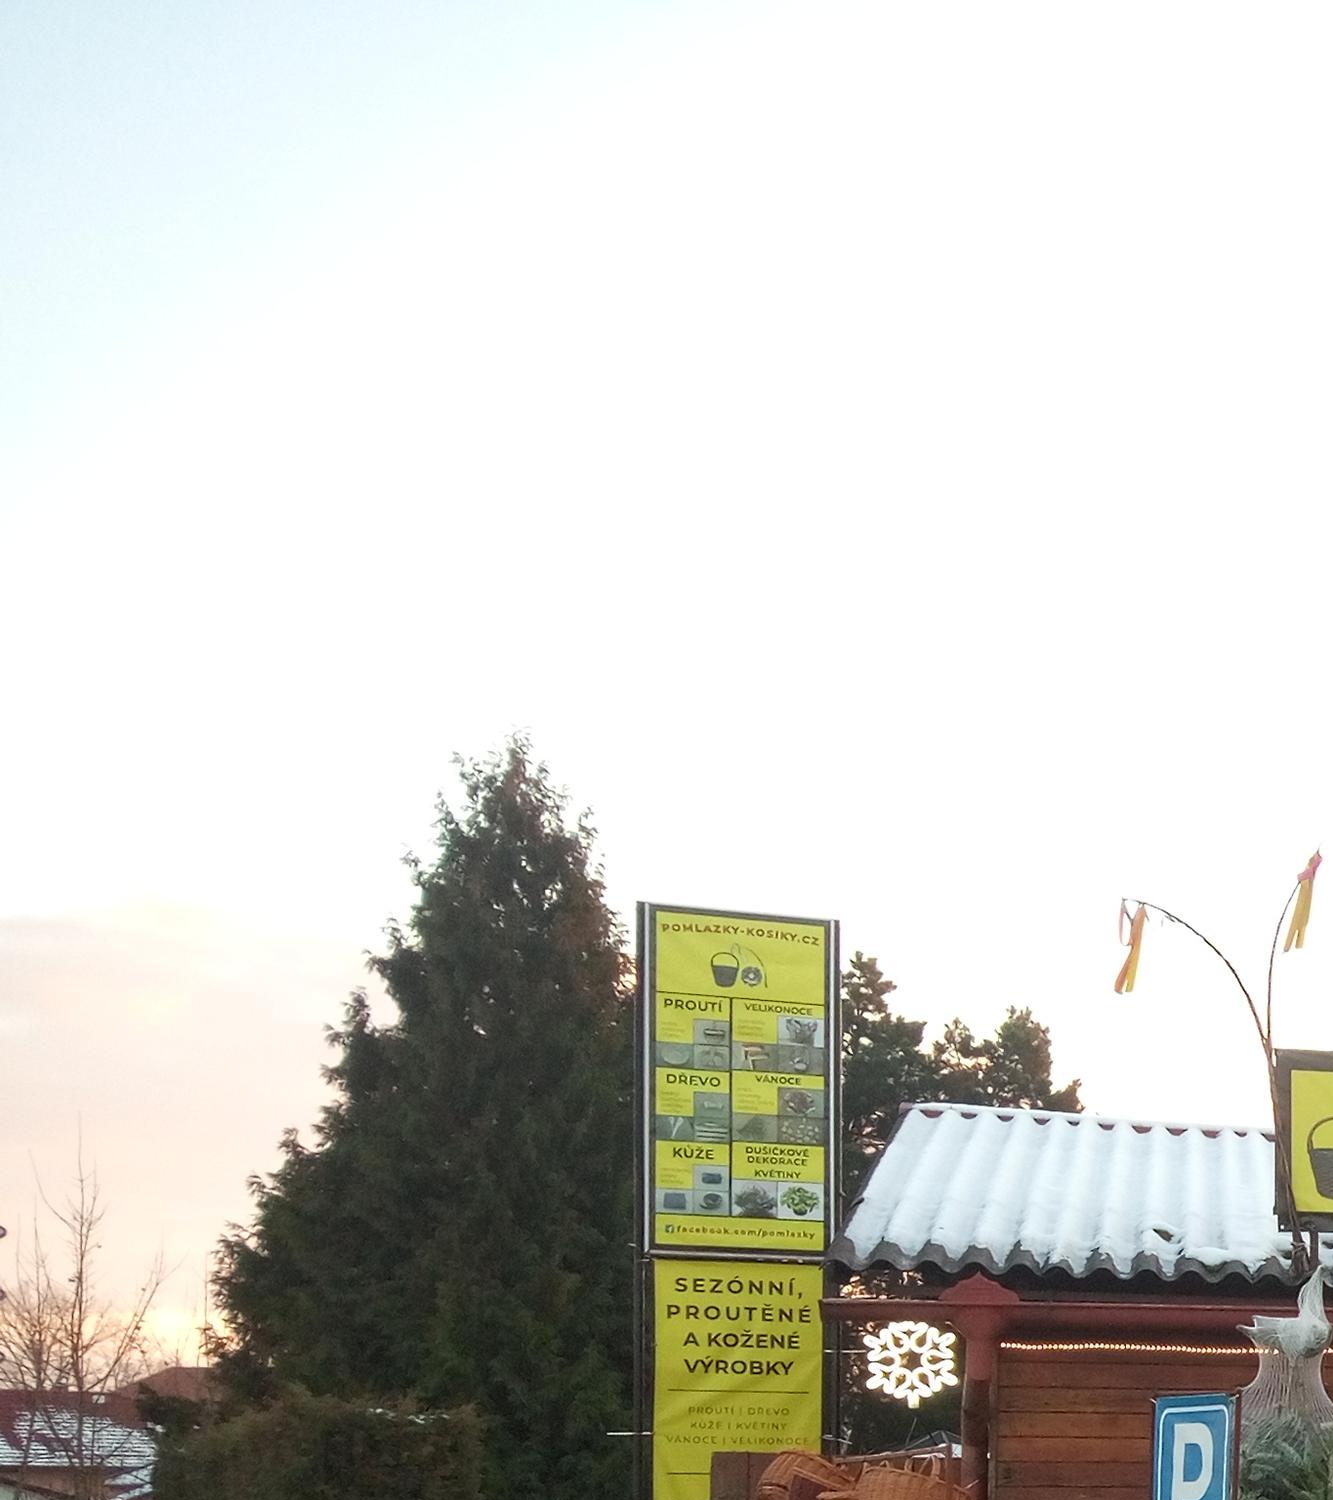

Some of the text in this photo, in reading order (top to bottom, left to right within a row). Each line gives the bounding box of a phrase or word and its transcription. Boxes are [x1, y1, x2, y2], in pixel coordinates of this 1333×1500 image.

[661, 921, 820, 946] POMLAZKY-KOSIKY.CZ
[664, 998, 722, 1013] PROUTÍ
[744, 1002, 813, 1016] VELIKONOCE
[666, 1071, 721, 1087] DŘEVO
[755, 1073, 801, 1086] VÁNOCE
[672, 1144, 715, 1160] KŮŽE
[745, 1145, 810, 1159] DUŠIČKOVÉ
[747, 1154, 808, 1167] DEKORACE
[754, 1166, 801, 1180] KVĚTINY
[674, 1276, 803, 1299] SEZÓNNÍ,
[666, 1304, 812, 1323] PROUTĚNÉ
[683, 1330, 800, 1349] A KOŽENÉ
[684, 1356, 794, 1376] VÝROBKY
[688, 1405, 735, 1416] PROUTÍ
